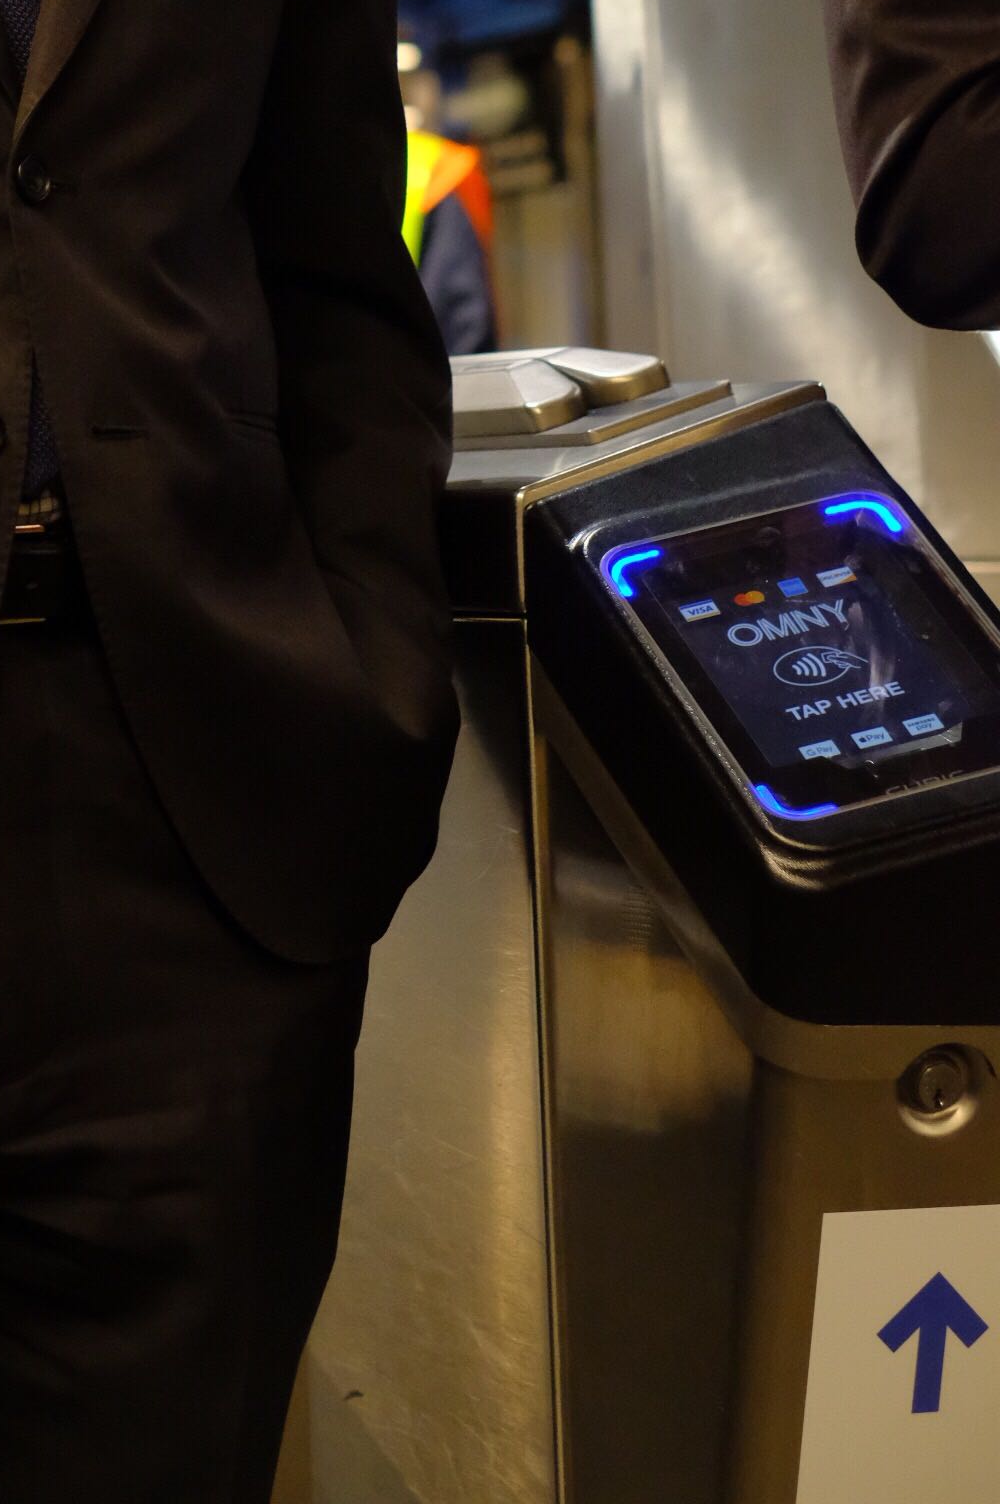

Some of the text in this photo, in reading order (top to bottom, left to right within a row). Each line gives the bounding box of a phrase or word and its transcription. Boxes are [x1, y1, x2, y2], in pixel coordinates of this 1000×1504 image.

[687, 605, 715, 616] VISA
[727, 598, 847, 647] OMNY
[785, 681, 905, 721] TAP HERE
[866, 731, 886, 743] Pay
[817, 744, 833, 756] Pay
